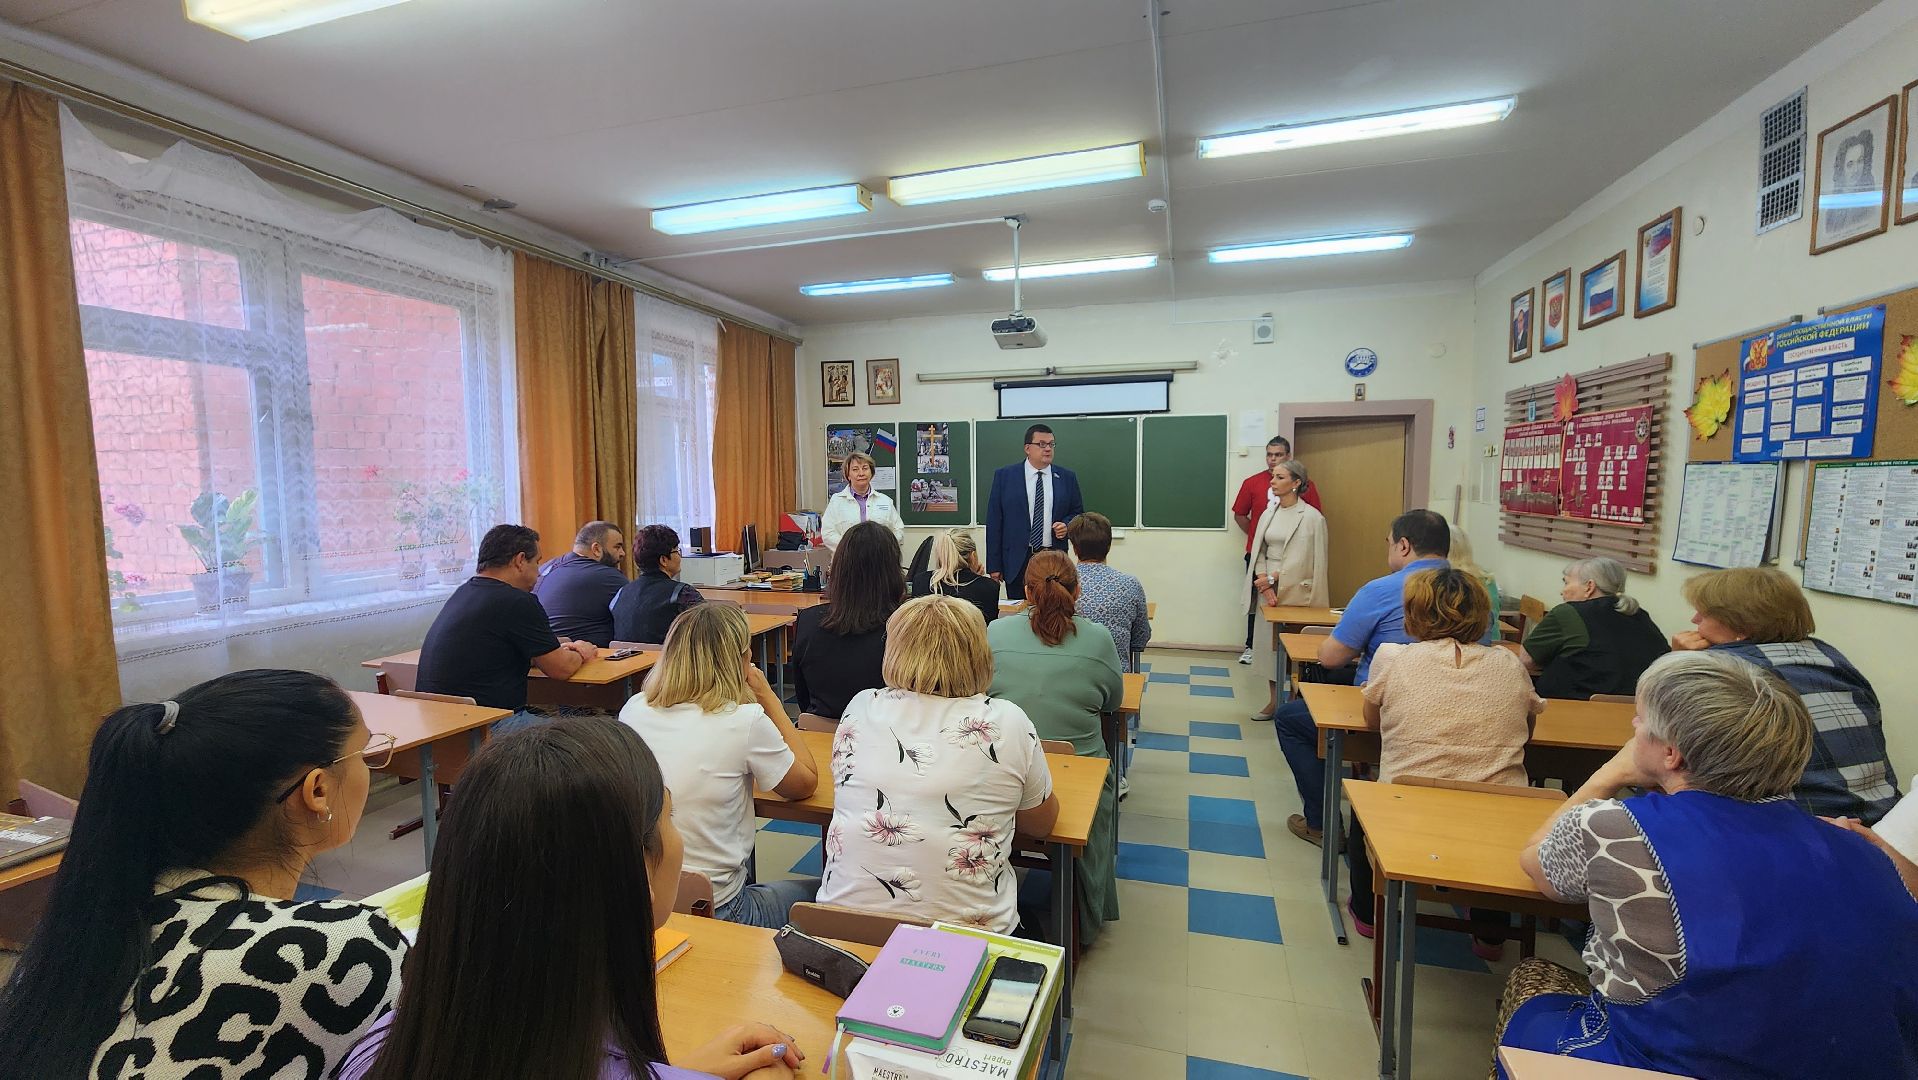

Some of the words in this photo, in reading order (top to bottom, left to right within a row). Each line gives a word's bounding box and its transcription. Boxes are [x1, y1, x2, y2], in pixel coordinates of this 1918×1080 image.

[1819, 321, 1870, 339] ФЕДЕРАЦИИ
[913, 948, 943, 959] EVERY
[945, 1053, 1009, 1079] MAESTRO
[983, 1054, 1012, 1066] expert
